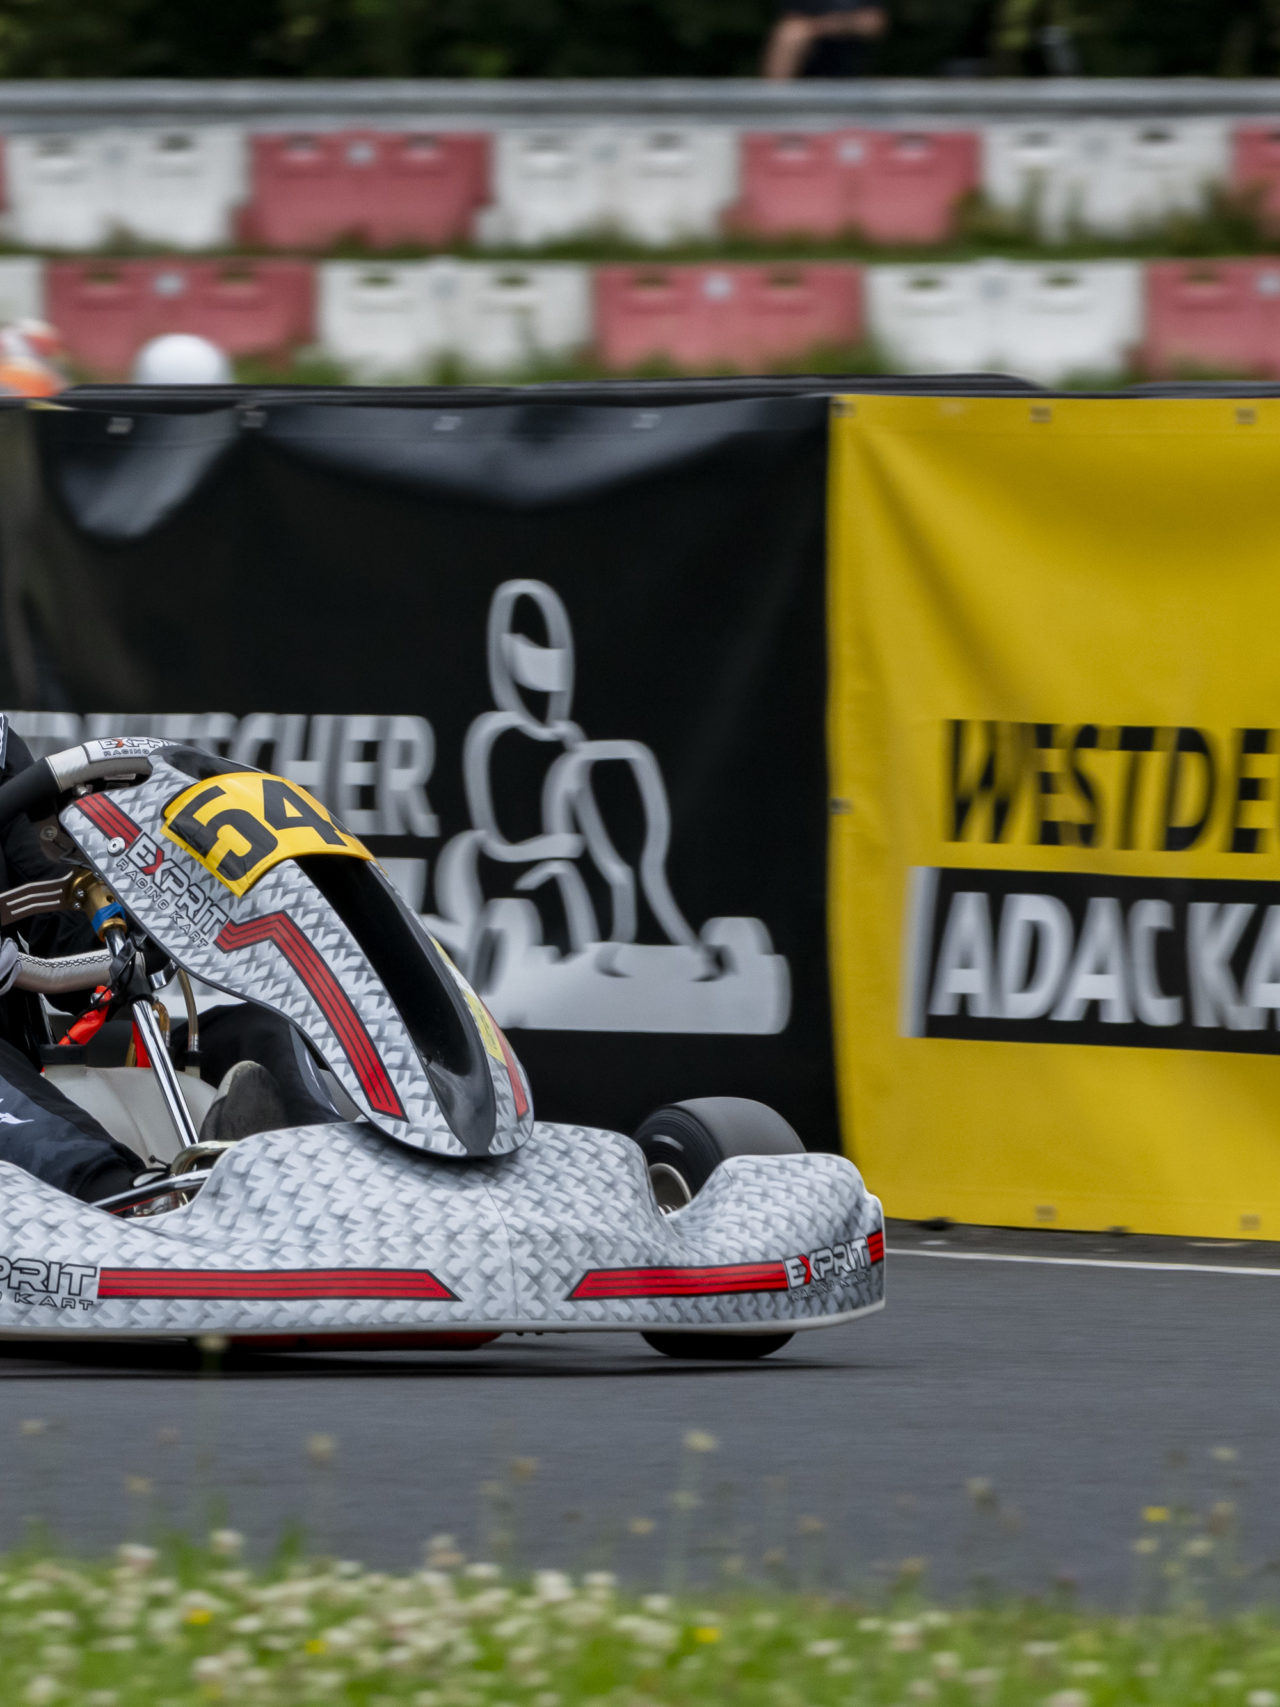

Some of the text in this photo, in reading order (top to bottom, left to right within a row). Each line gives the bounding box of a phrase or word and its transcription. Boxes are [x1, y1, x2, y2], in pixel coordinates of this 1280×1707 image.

[168, 779, 352, 882] 54
[942, 718, 1280, 854] WESTDE
[116, 858, 209, 948] RACING KART
[125, 832, 229, 936] EXPRIT
[14, 1293, 94, 1311] KART
[784, 1237, 870, 1290] EXPRIT
